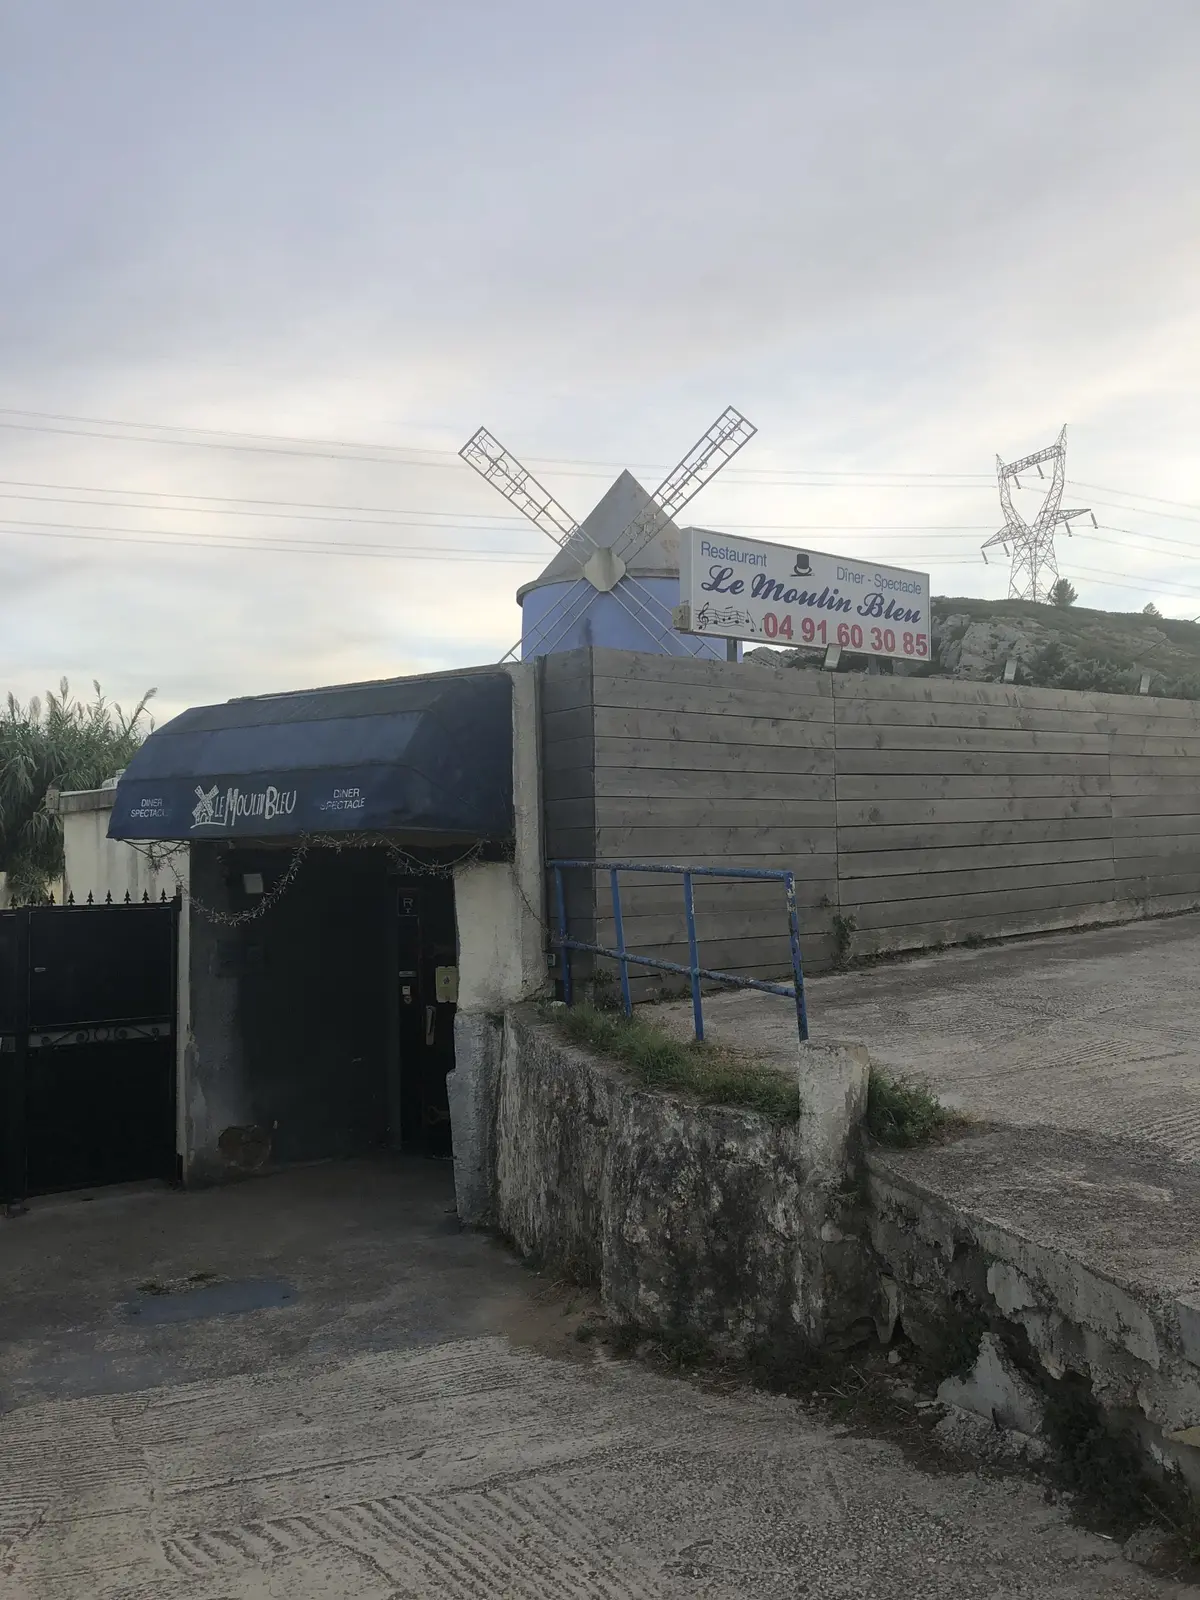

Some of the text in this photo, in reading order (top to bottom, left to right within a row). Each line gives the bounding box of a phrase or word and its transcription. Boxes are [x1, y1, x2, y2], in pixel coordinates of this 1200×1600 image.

[701, 541, 767, 567] Restaurant
[701, 565, 921, 623] Le Moulin Bleu
[837, 566, 865, 584] Dîner
[874, 574, 922, 595] Spectacle
[763, 612, 928, 656] 04 91 60 30 85
[214, 796, 225, 817] LE
